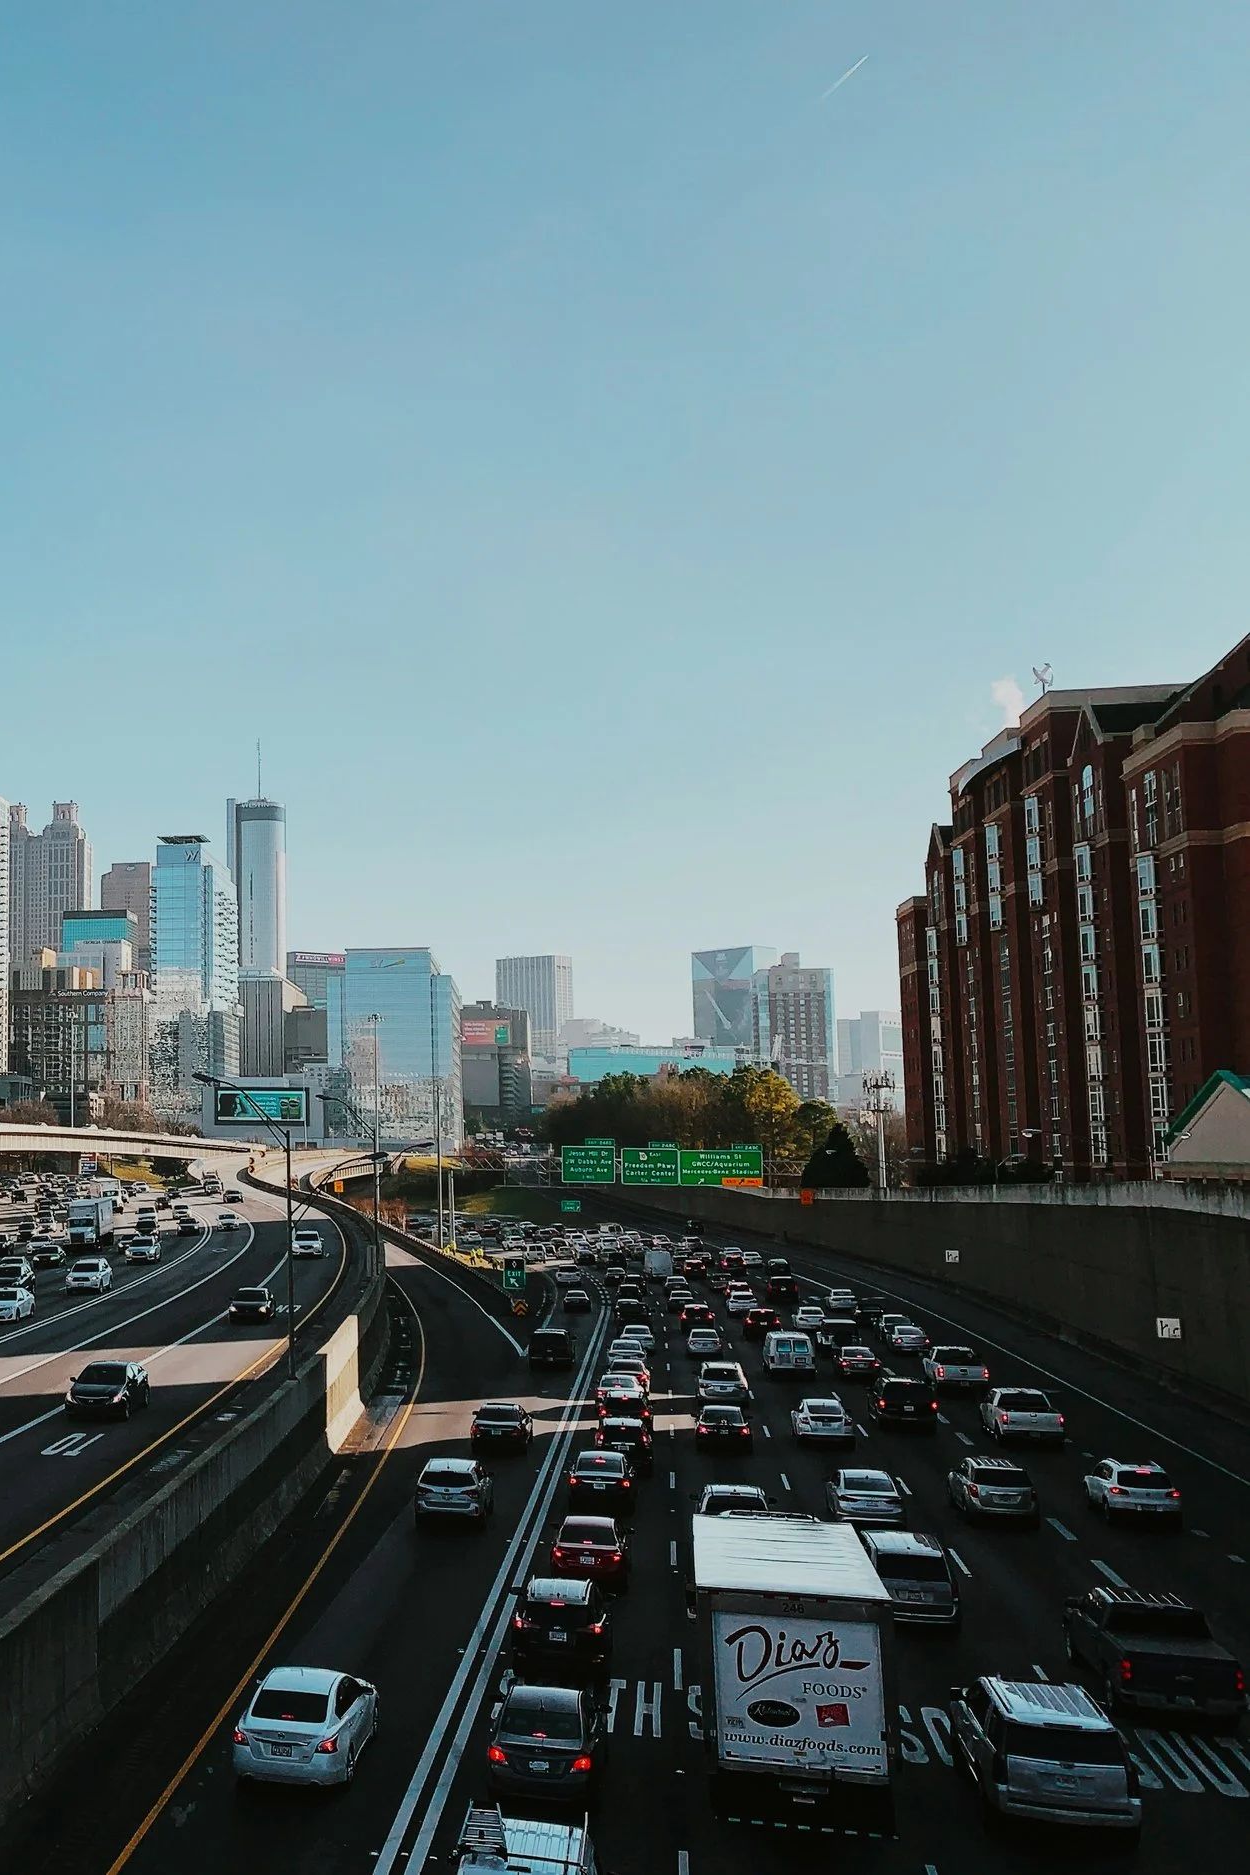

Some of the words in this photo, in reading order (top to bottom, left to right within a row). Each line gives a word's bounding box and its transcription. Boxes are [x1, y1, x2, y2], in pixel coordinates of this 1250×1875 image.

[657, 1162, 676, 1170] Pkwy
[782, 1603, 805, 1614] 246
[724, 1624, 840, 1683] Diaz
[802, 1682, 863, 1699] FOODS
[724, 1732, 882, 1757] www.diazfoods.com
